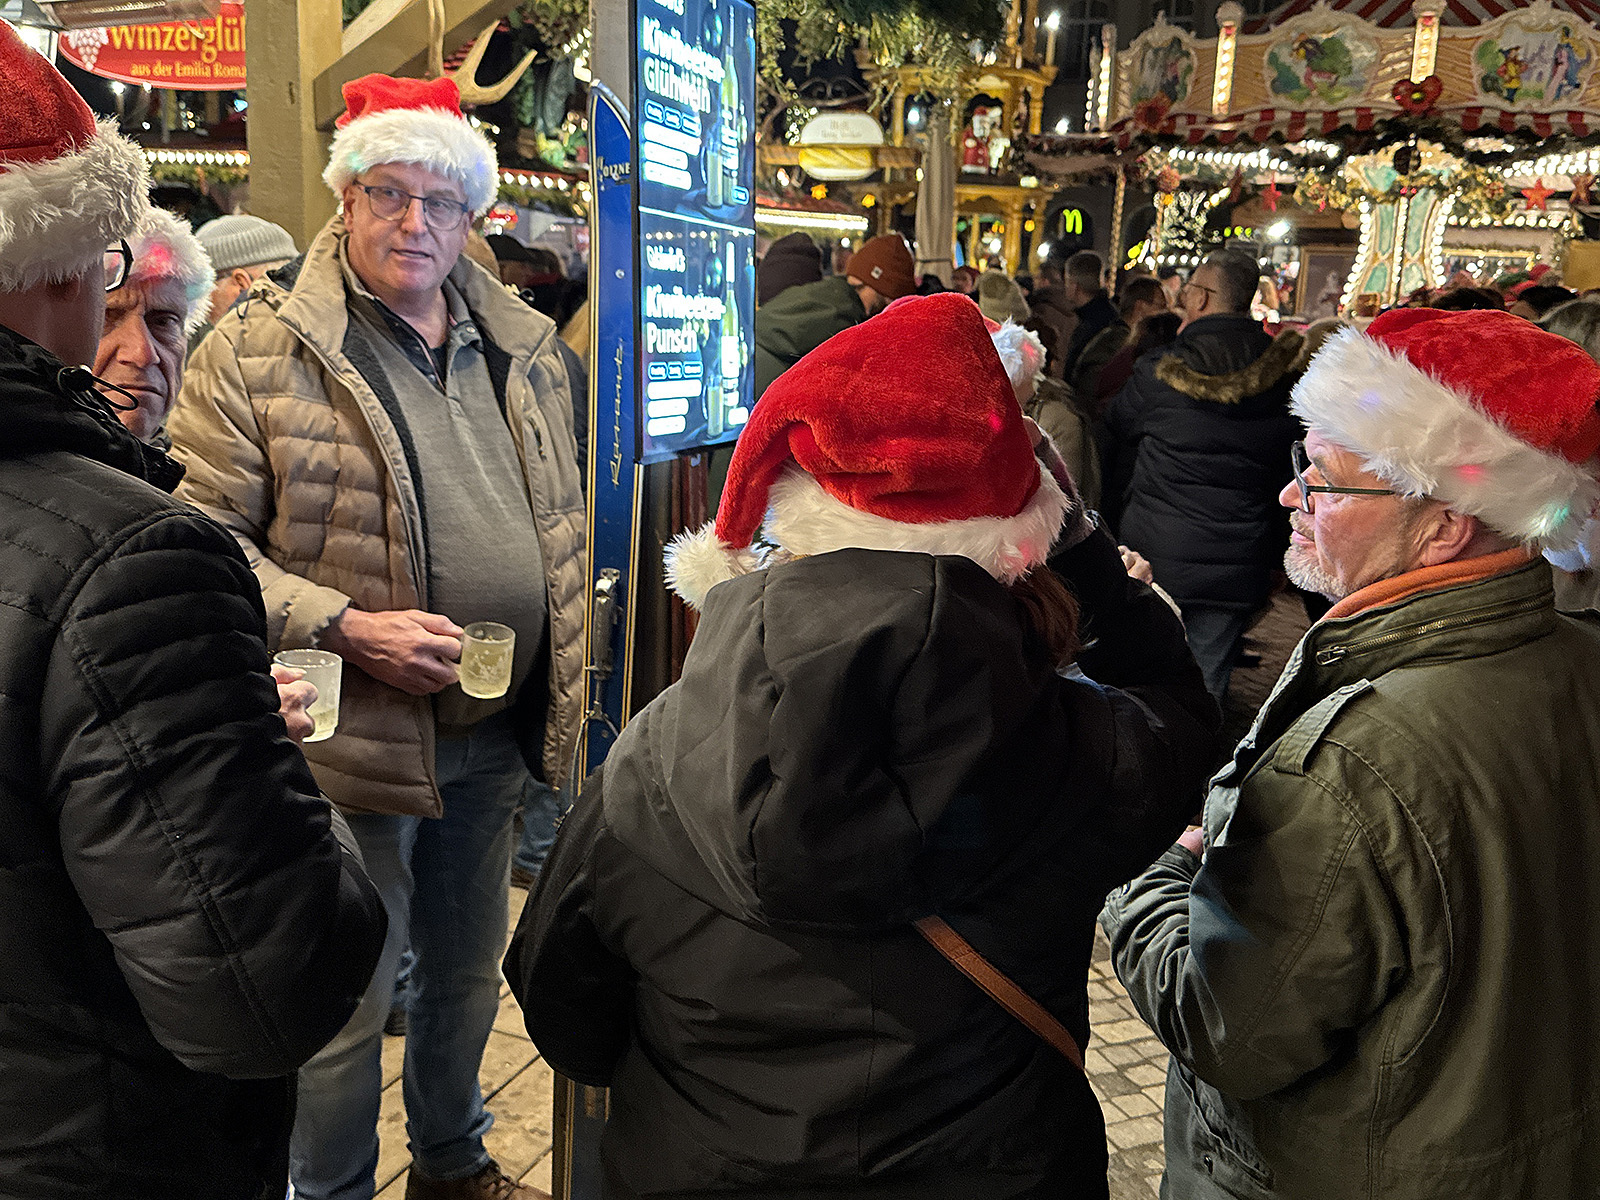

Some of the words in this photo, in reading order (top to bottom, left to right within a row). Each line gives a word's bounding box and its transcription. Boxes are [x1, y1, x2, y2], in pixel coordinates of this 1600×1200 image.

[131, 63, 151, 76] aus
[152, 60, 173, 76] der
[175, 60, 211, 77] Emilia
[643, 56, 712, 114] Glühwein
[645, 321, 698, 354] Punsch
